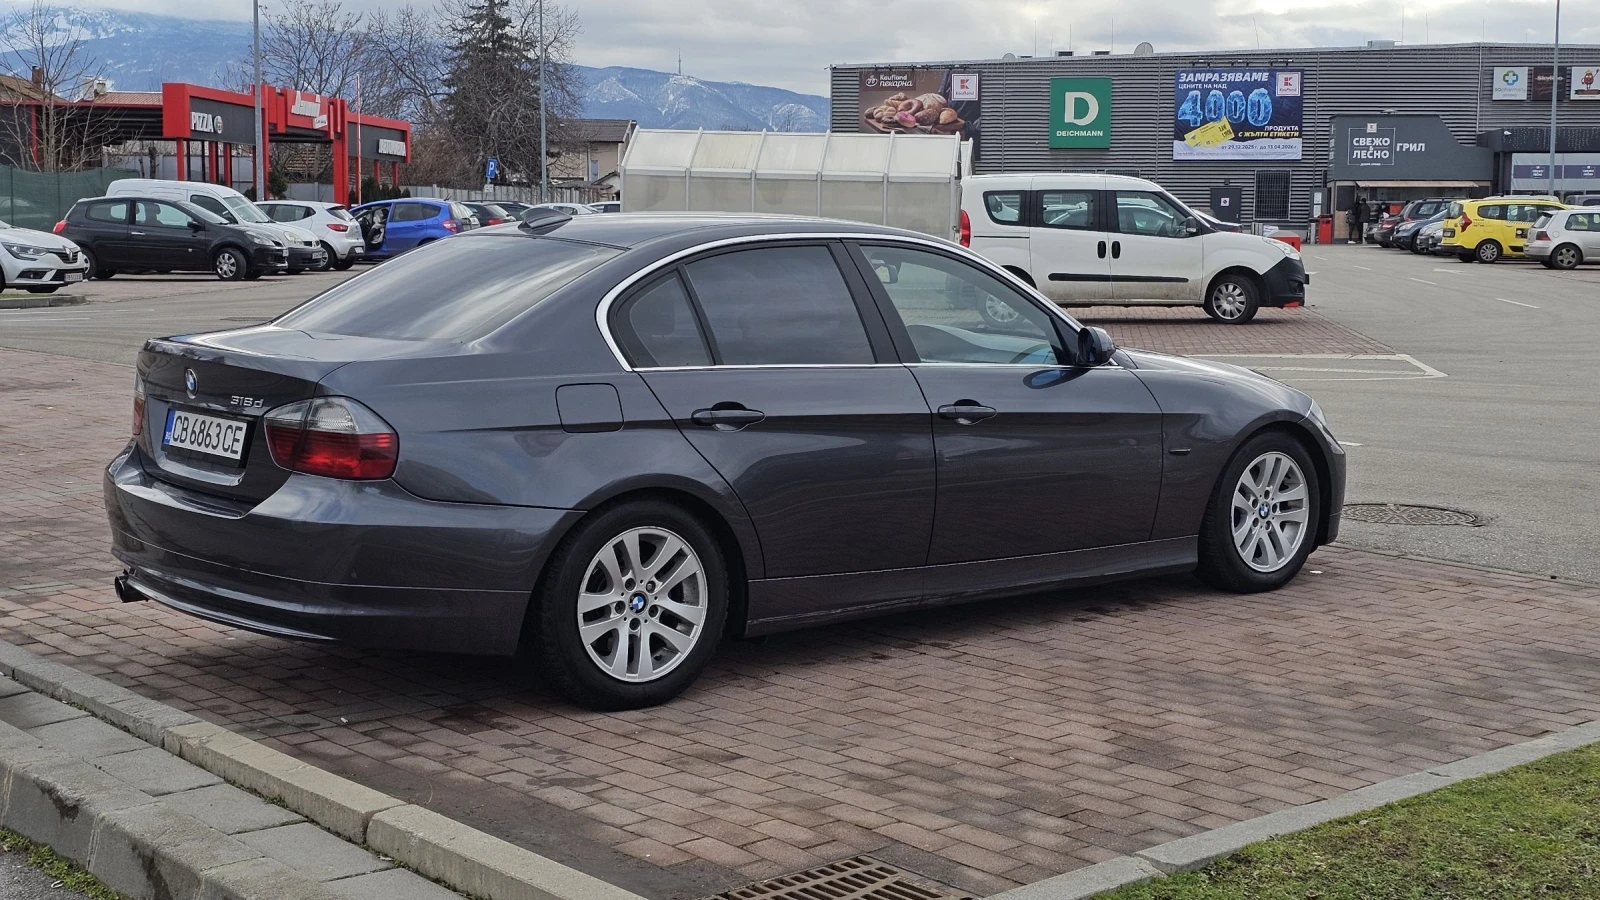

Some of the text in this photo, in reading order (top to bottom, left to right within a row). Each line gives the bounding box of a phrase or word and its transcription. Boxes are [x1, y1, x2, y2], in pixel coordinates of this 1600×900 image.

[1179, 72, 1270, 82] ЗАМРАЗЯВАМЕ
[880, 80, 913, 88] пекарна
[1064, 91, 1099, 126] D
[1178, 88, 1272, 127] 4000
[191, 111, 214, 133] PIZZA
[1353, 137, 1391, 146] СВЕЖО
[1396, 143, 1426, 152] ГРИЛ
[1352, 150, 1390, 159] ЛЕСНО
[488, 161, 495, 175] P
[231, 396, 263, 407] 318d
[173, 416, 242, 454] CB 6863 CE
